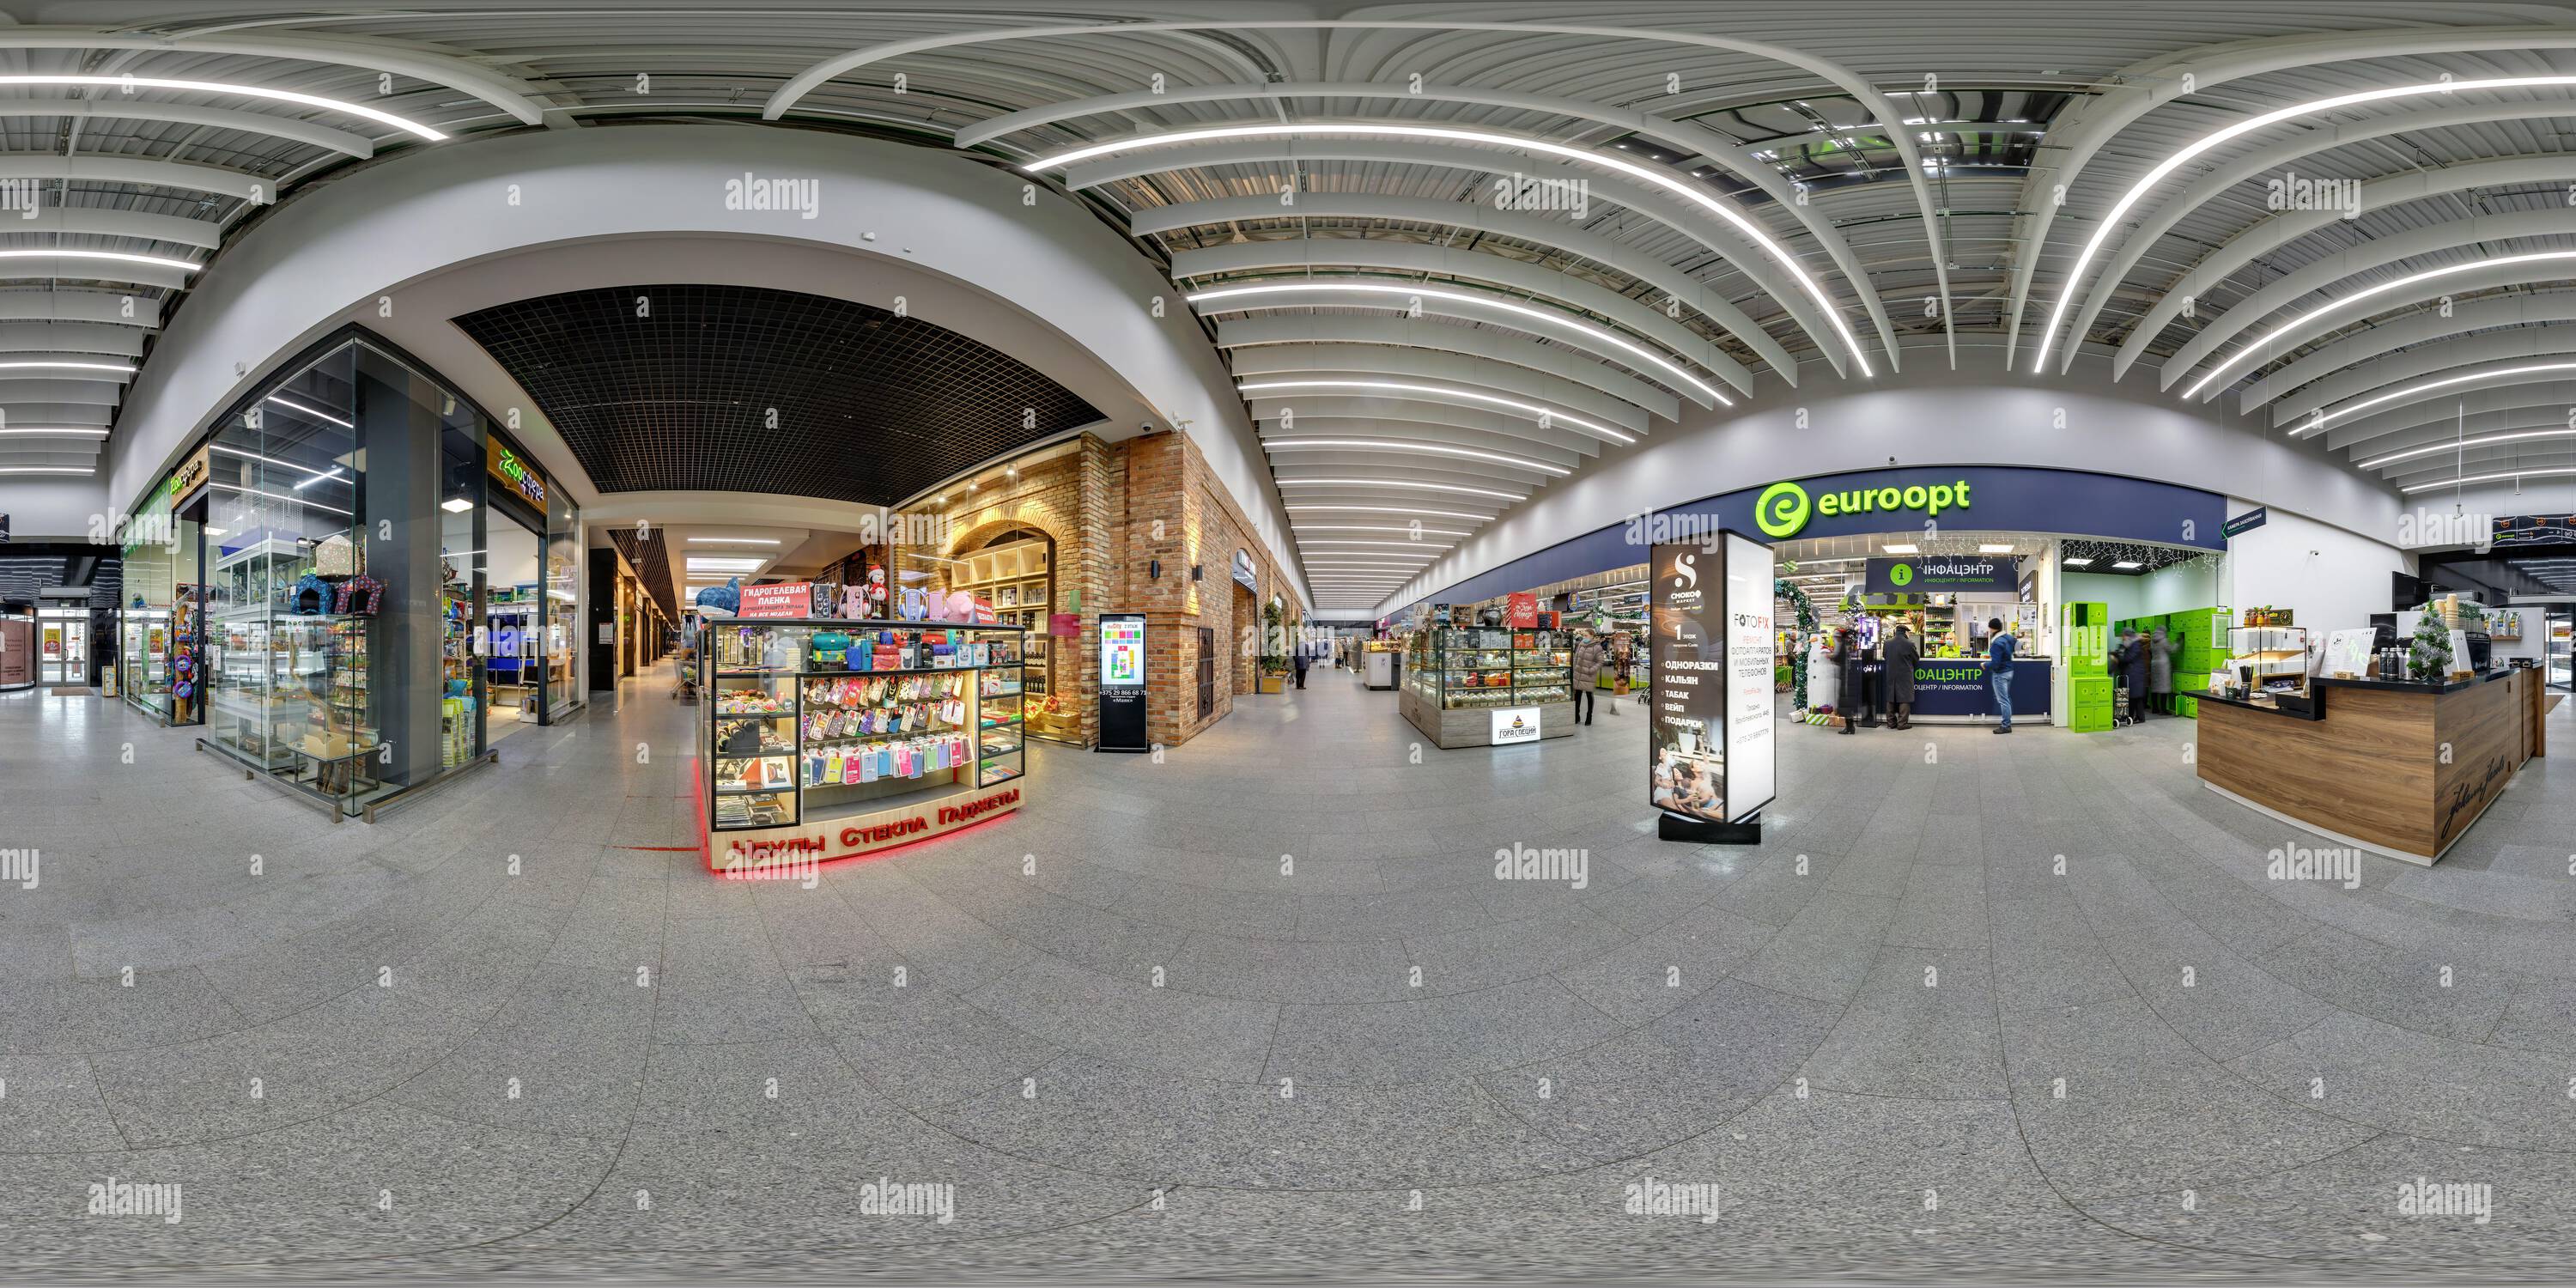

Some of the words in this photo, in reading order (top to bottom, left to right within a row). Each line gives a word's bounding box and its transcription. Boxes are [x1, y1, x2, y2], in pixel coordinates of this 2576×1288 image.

[1818, 479, 1971, 517] euroopt
[1923, 564, 1994, 578] ІНФАЦЭНТР
[744, 585, 807, 597] ГИДРОГЕЛЕВАЯ
[758, 596, 791, 605] ПЛЕНКА
[1674, 624, 1681, 641] 1
[1665, 660, 1719, 671] ОДНОРАЗКИ
[1739, 657, 1769, 666] МОБИЛЬНЫХ
[1739, 667, 1766, 677] ТЕЛЕФОНОВ
[1665, 675, 1698, 685] КАЛЬЯН
[1665, 690, 1690, 700] ТАБАК
[1664, 702, 1685, 713] ВЕЙП
[1664, 716, 1702, 728] ПОДАРКИ
[1499, 727, 1515, 738] ГОРА
[1515, 726, 1537, 738] СПЕЦИЙ
